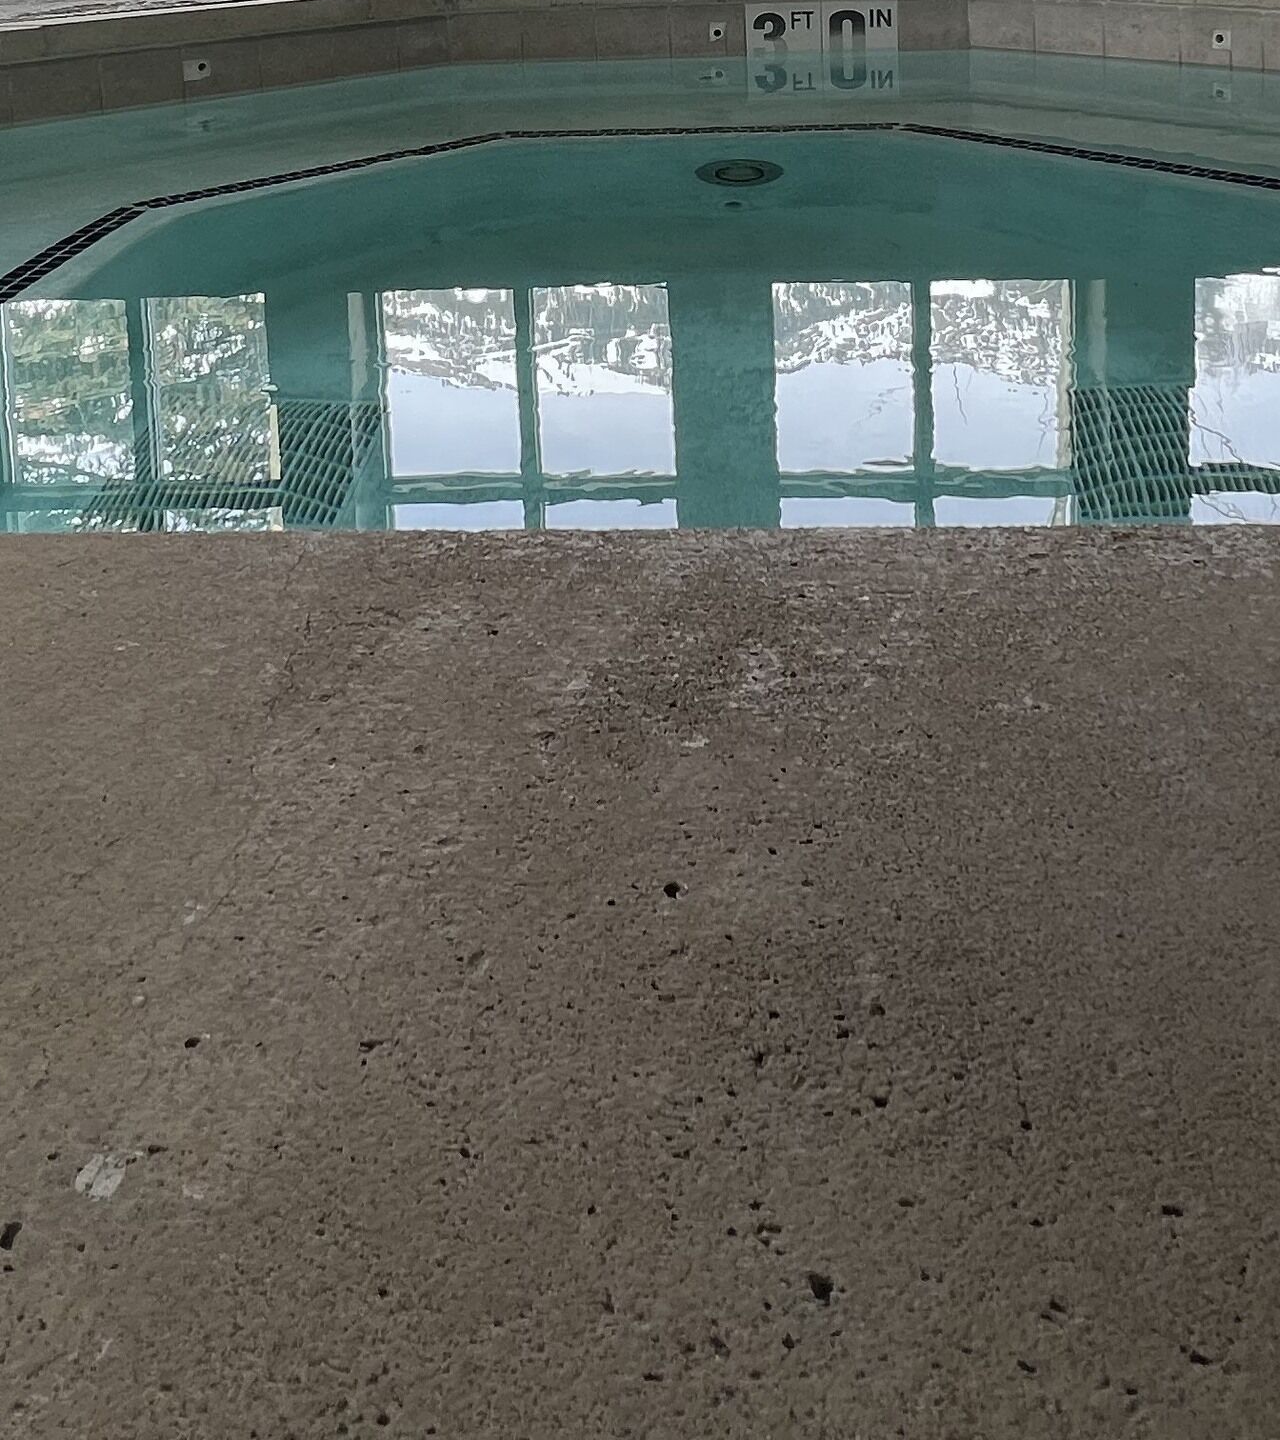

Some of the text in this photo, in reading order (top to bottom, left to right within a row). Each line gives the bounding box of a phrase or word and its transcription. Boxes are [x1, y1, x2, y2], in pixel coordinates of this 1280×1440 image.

[752, 11, 788, 68] 3
[790, 10, 815, 30] FT
[869, 8, 892, 28] IN
